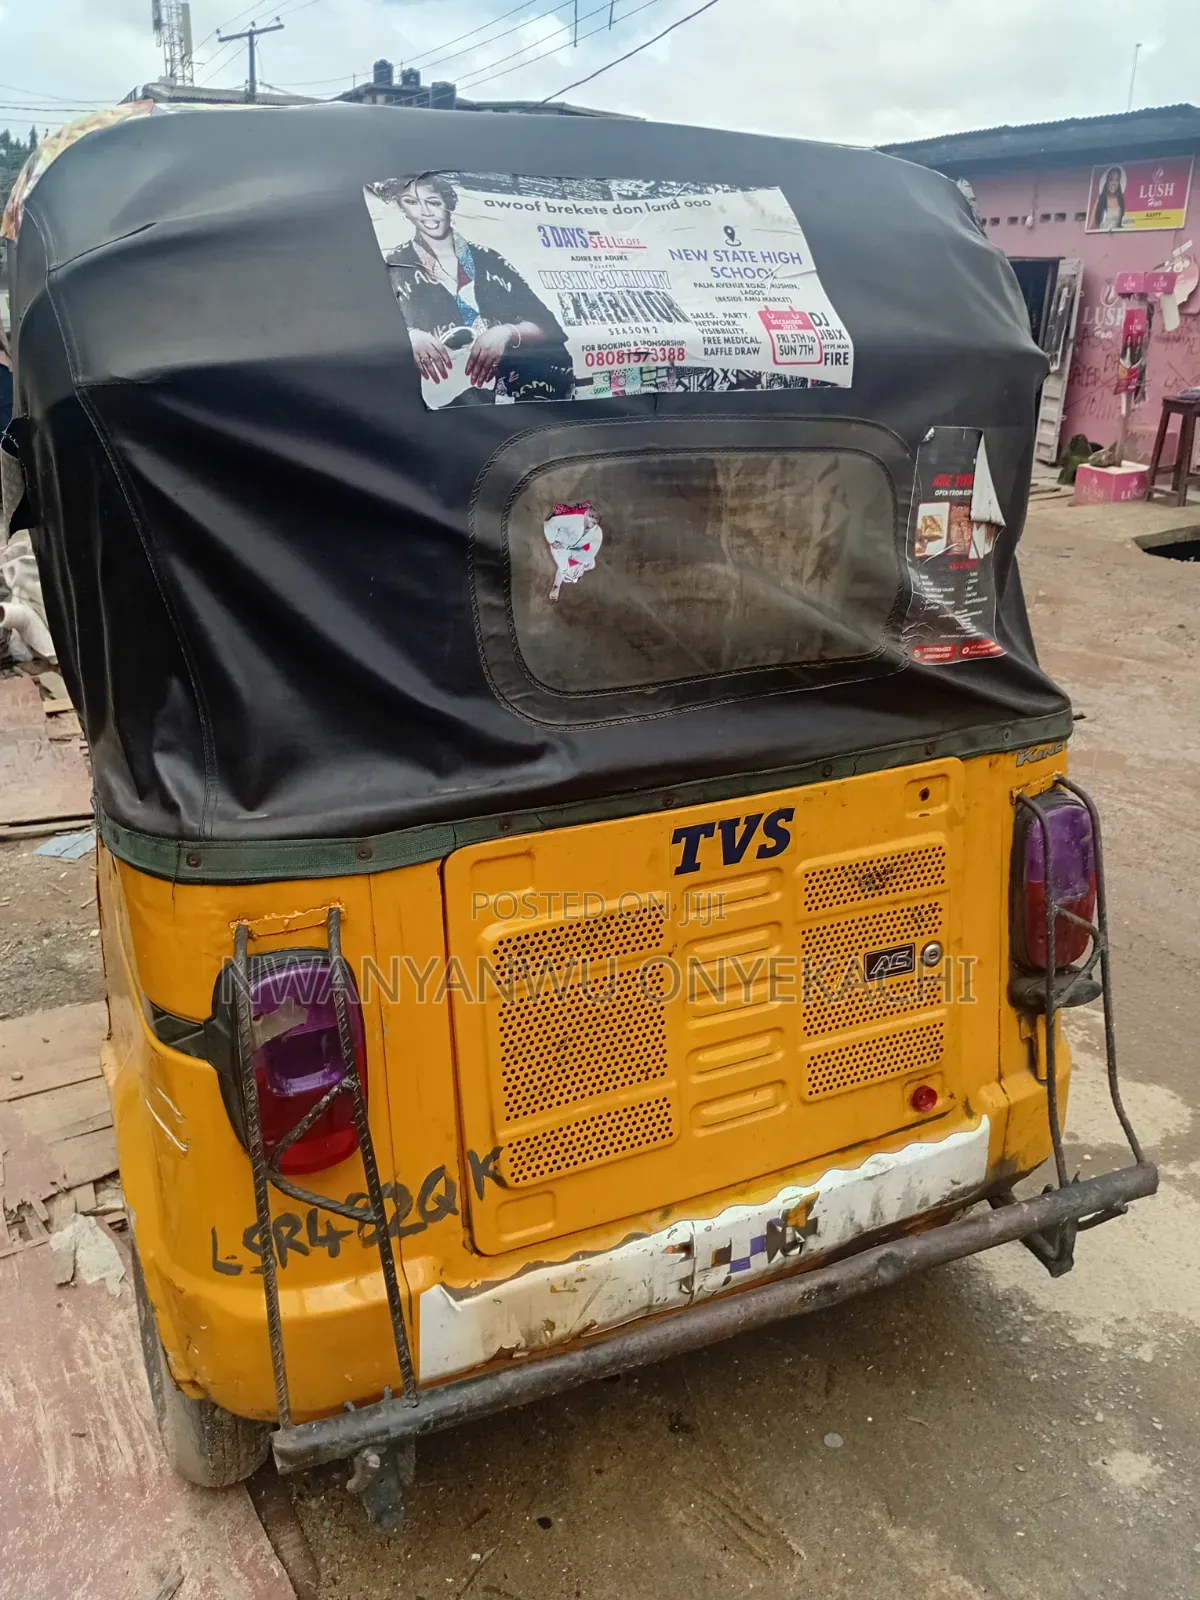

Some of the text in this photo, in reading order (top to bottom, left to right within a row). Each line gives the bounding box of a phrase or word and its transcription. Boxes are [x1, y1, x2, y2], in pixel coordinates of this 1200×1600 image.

[1139, 183, 1175, 198] LUSH
[484, 199, 712, 215] awoof brekete don land ooo
[537, 225, 551, 248] 3
[550, 226, 589, 248] DAYS
[588, 236, 618, 249] SELL
[626, 238, 641, 246] OFF
[668, 249, 803, 265] NEW STATE HIGH
[538, 270, 673, 289] MUSHIN COMMUNITY
[808, 312, 830, 327] DJ
[608, 326, 659, 336] SEASON 2
[819, 329, 846, 341] JIBIX
[776, 334, 789, 343] FRI
[790, 334, 806, 343] 5TH
[597, 341, 632, 351] BOOKING
[704, 347, 760, 356] RAFFLE DRAW
[779, 345, 814, 356] SUN 7TH
[824, 352, 849, 366] FIRE
[671, 807, 796, 876] TVS
